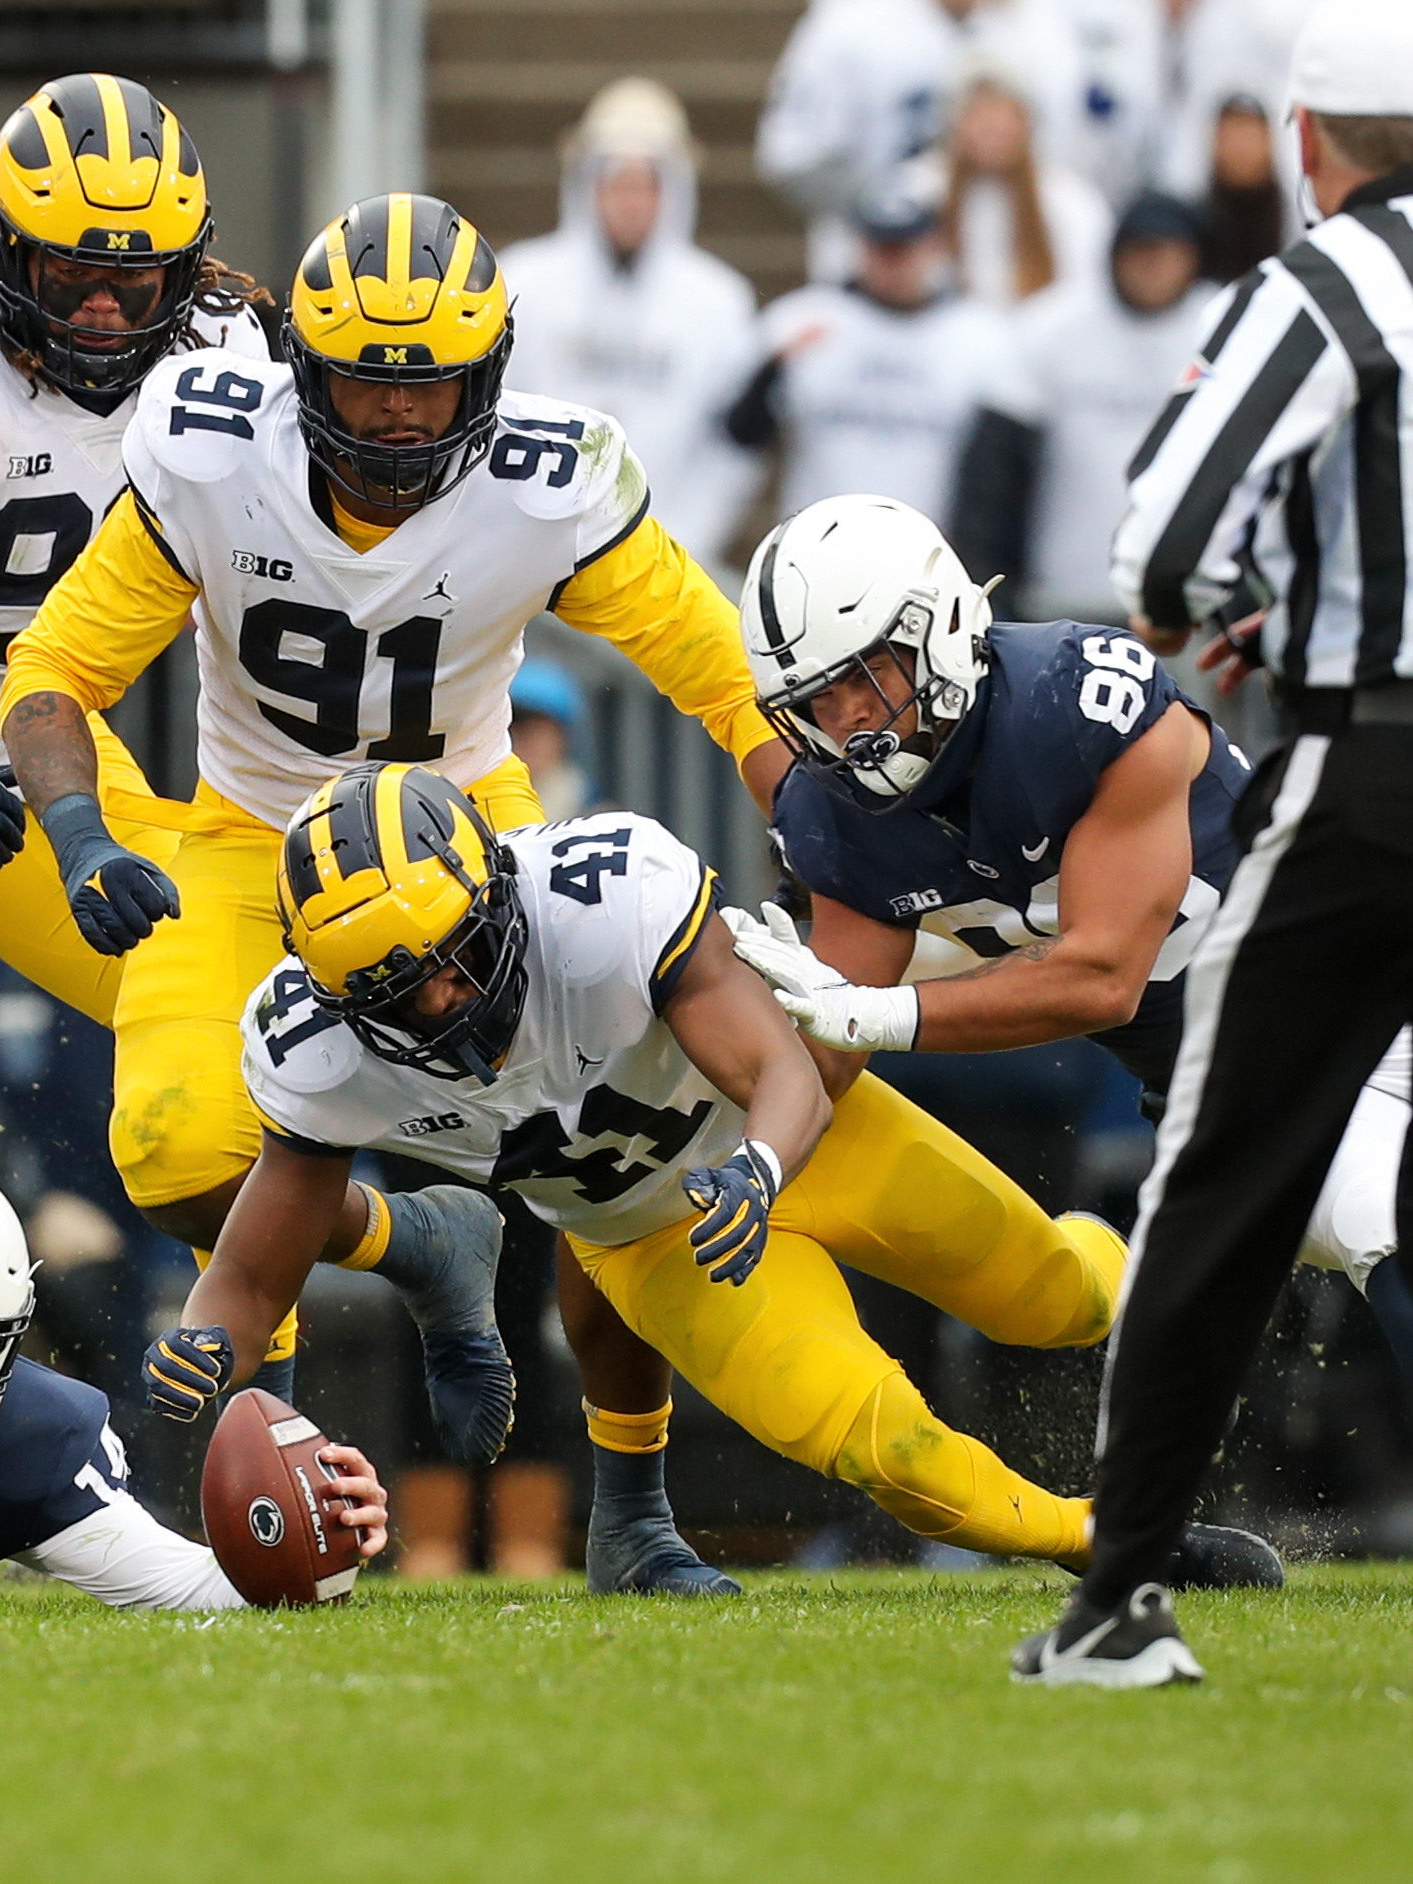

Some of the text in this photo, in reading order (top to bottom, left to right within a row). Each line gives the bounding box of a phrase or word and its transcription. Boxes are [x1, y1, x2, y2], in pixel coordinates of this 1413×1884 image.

[107, 232, 131, 250] M
[383, 346, 408, 365] M
[169, 366, 265, 442] 91
[488, 414, 585, 489] 91
[239, 598, 446, 763] 91
[1078, 635, 1157, 735] 86
[550, 827, 633, 906] 41
[256, 969, 343, 1069] 41
[478, 1082, 715, 1205] 41
[311, 1513, 328, 1554] ELITE
